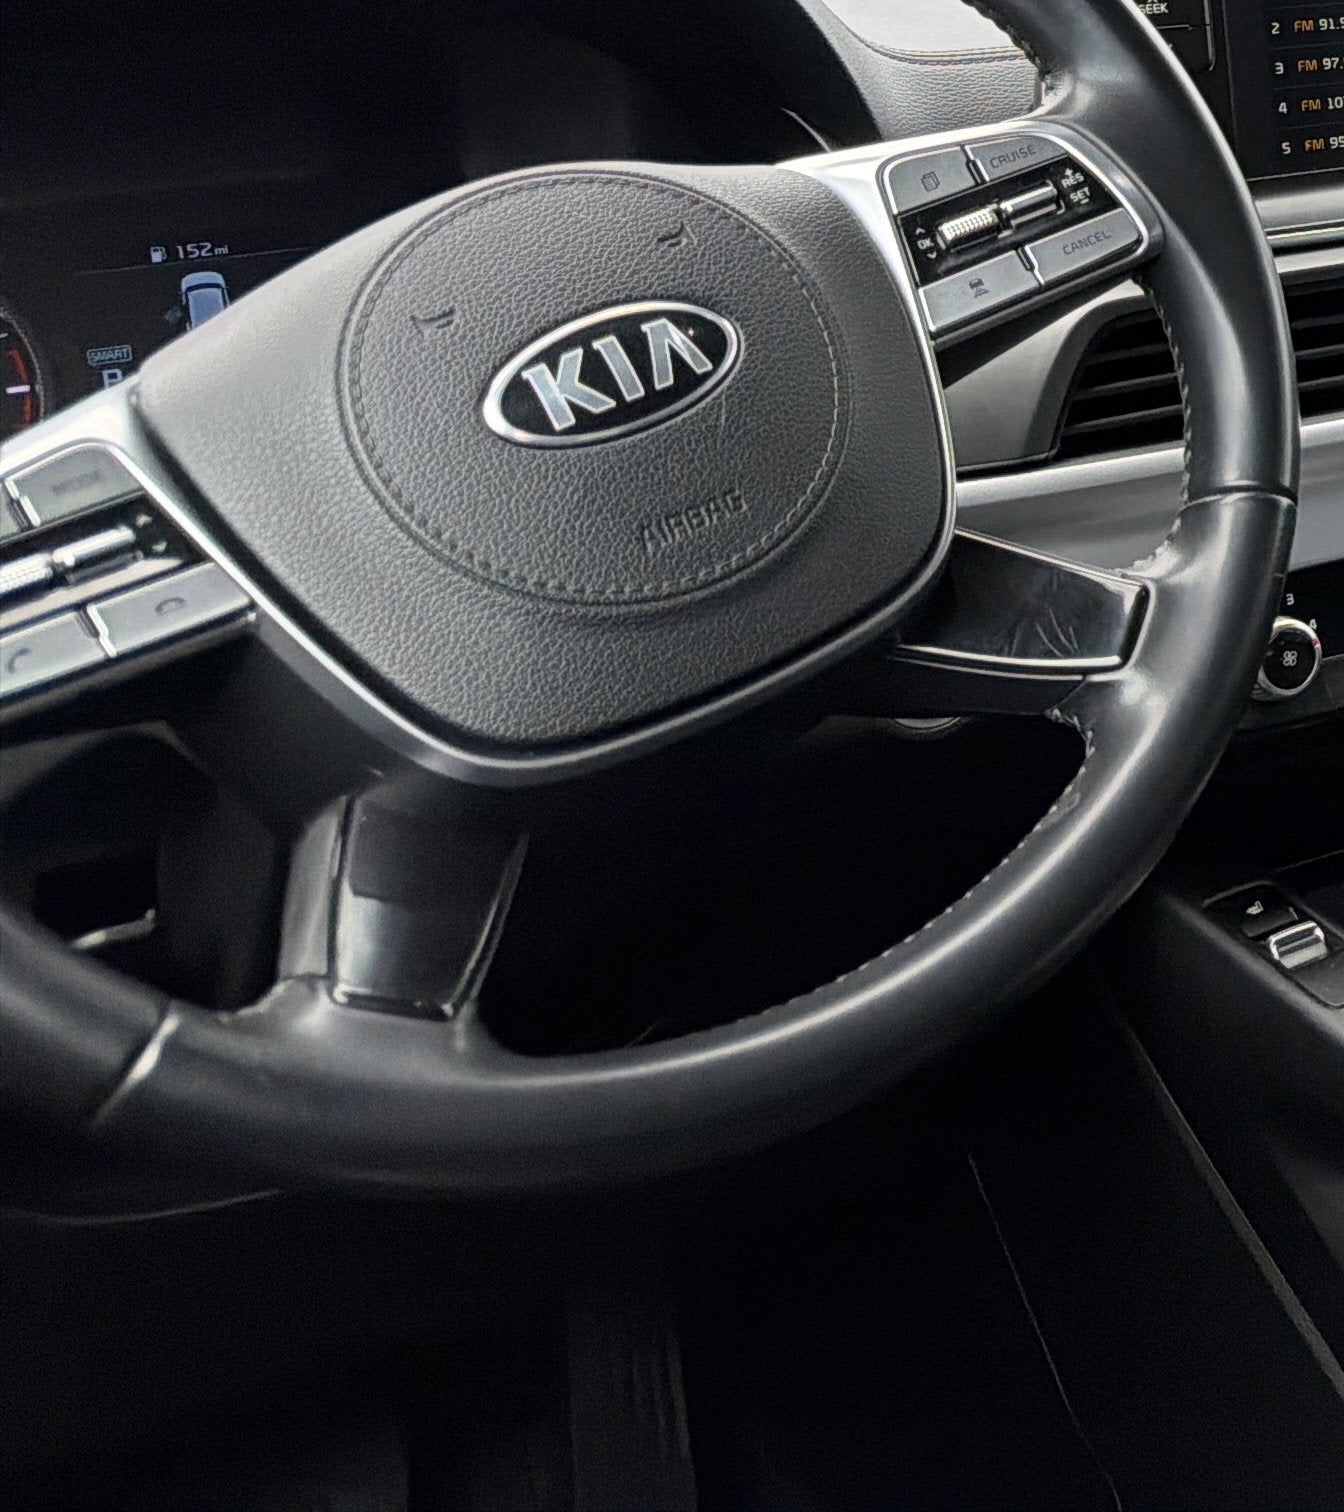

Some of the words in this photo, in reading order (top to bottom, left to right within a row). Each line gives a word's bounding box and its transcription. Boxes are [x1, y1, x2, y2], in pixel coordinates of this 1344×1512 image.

[1271, 22, 1281, 35] 2
[1294, 19, 1314, 32] FM
[1274, 62, 1285, 75] 3
[1297, 59, 1318, 73] FM
[1278, 102, 1288, 115] 4
[1301, 98, 1322, 112] FM
[1281, 142, 1292, 155] 5
[1304, 139, 1325, 153] FM
[989, 144, 1037, 169] CRUISE
[1061, 172, 1085, 189] RES
[1069, 186, 1091, 200] SET
[176, 242, 213, 259] 152
[214, 245, 229, 256] mi
[917, 237, 935, 250] OK
[1062, 230, 1113, 256] CANCEL
[89, 348, 129, 363] SMART
[522, 318, 713, 431] KIA
[1285, 593, 1295, 606] 3
